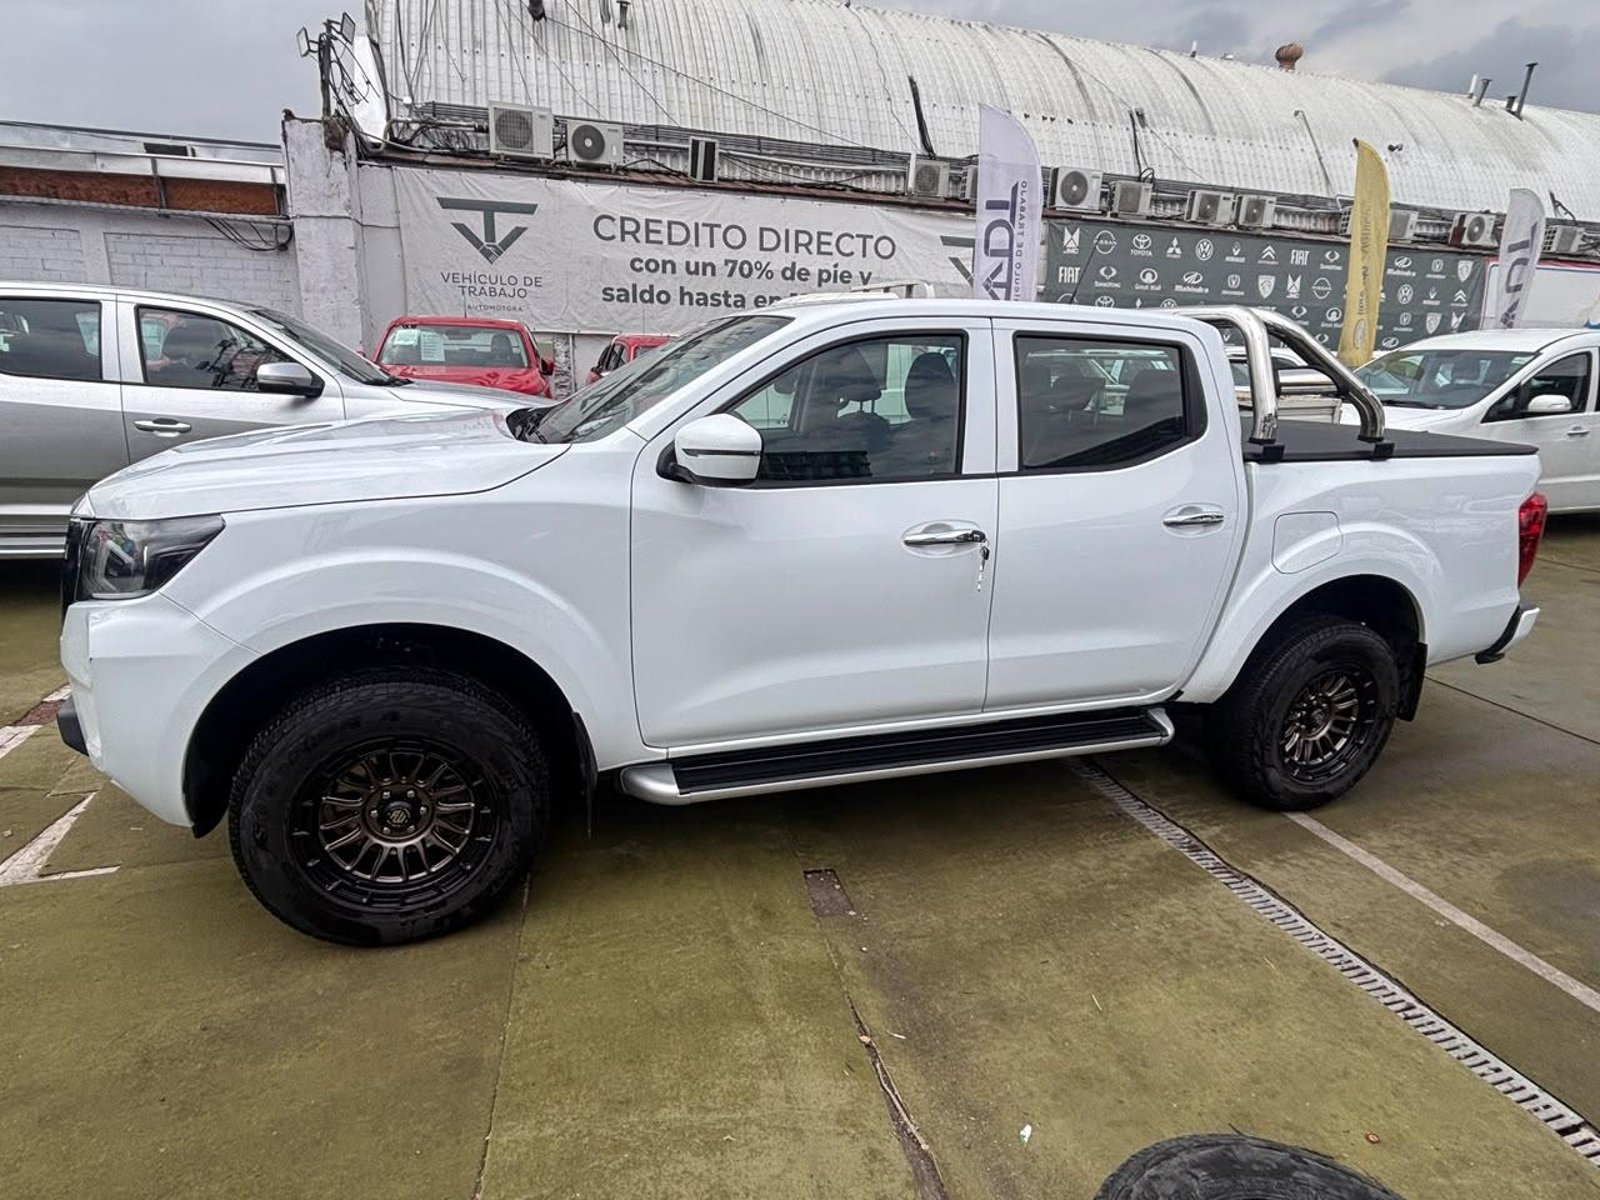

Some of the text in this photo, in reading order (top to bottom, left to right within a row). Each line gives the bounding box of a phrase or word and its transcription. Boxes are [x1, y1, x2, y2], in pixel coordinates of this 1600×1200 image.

[593, 214, 896, 259] CREDITO DIRECTO
[1290, 249, 1309, 265] FIAT
[630, 257, 676, 274] con
[686, 261, 716, 277] un
[724, 259, 774, 280] 70%
[781, 262, 810, 281] de
[1058, 266, 1080, 283] FIAT
[441, 271, 542, 287] VEHÍCULO DE
[458, 285, 527, 298] TRABAJO
[602, 284, 671, 305] saldo
[679, 287, 746, 308] hasta
